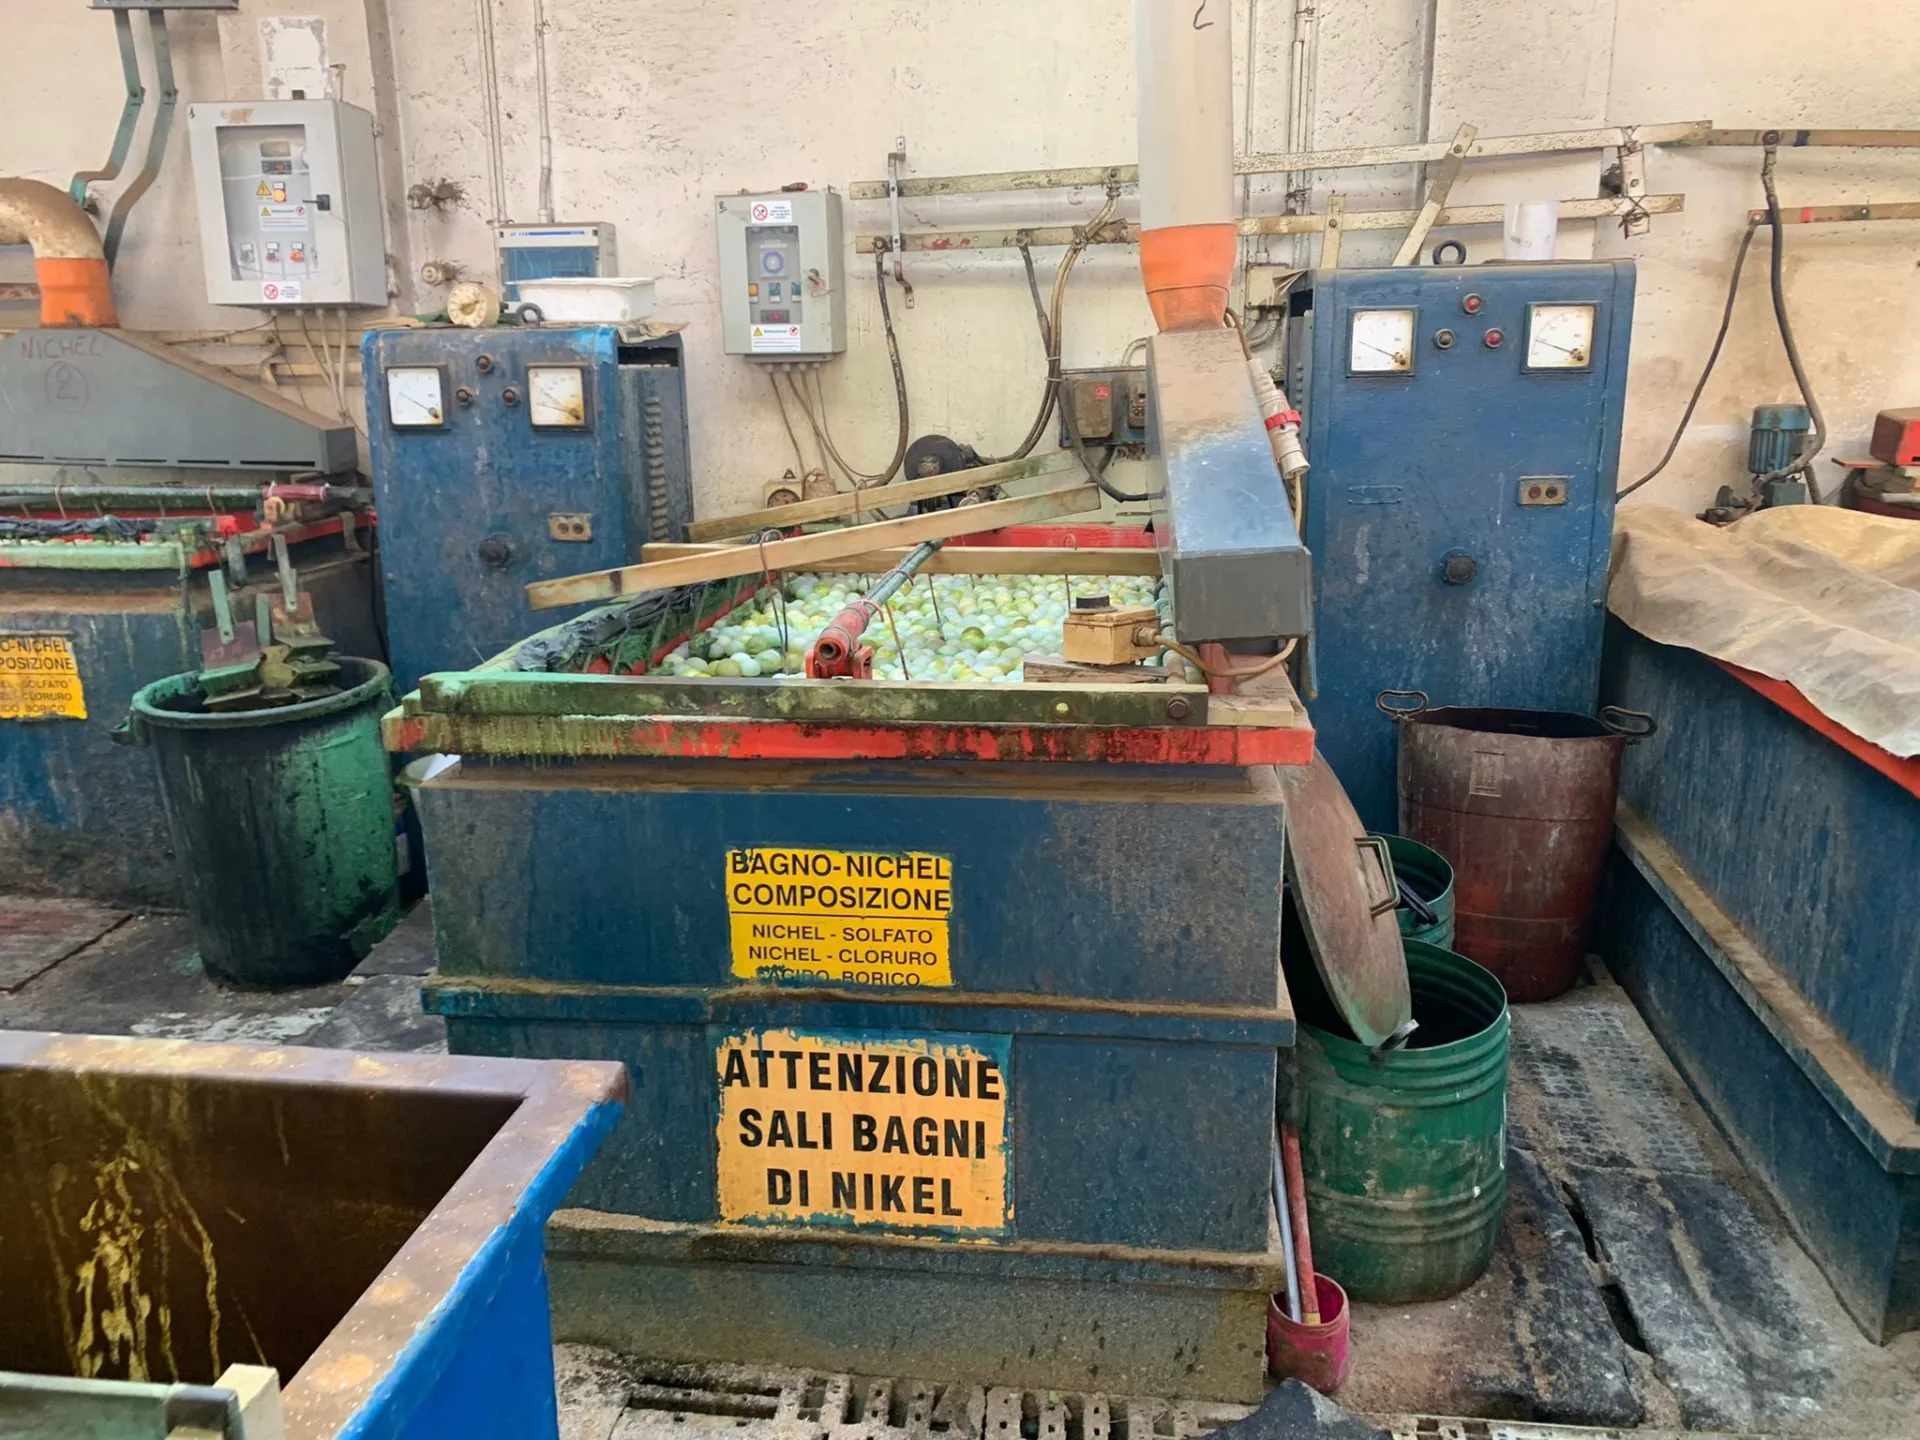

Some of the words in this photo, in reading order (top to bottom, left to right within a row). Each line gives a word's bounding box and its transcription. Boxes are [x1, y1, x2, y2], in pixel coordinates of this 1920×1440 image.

[20, 335, 102, 360] NICHEL
[55, 364, 78, 400] 2
[733, 883, 950, 911] COMPOSIZIONE
[752, 924, 825, 941] NICHEL
[842, 927, 933, 944] SOLFATO
[749, 945, 821, 962] NICHEL
[838, 949, 938, 966] CLORURO
[841, 971, 920, 986] BORICO
[724, 1049, 1000, 1101] ATTENZIONE
[739, 1108, 833, 1150] SALI
[853, 1114, 986, 1160] BAGNI
[767, 1167, 808, 1206] DI
[832, 1171, 963, 1217] NIKEL
